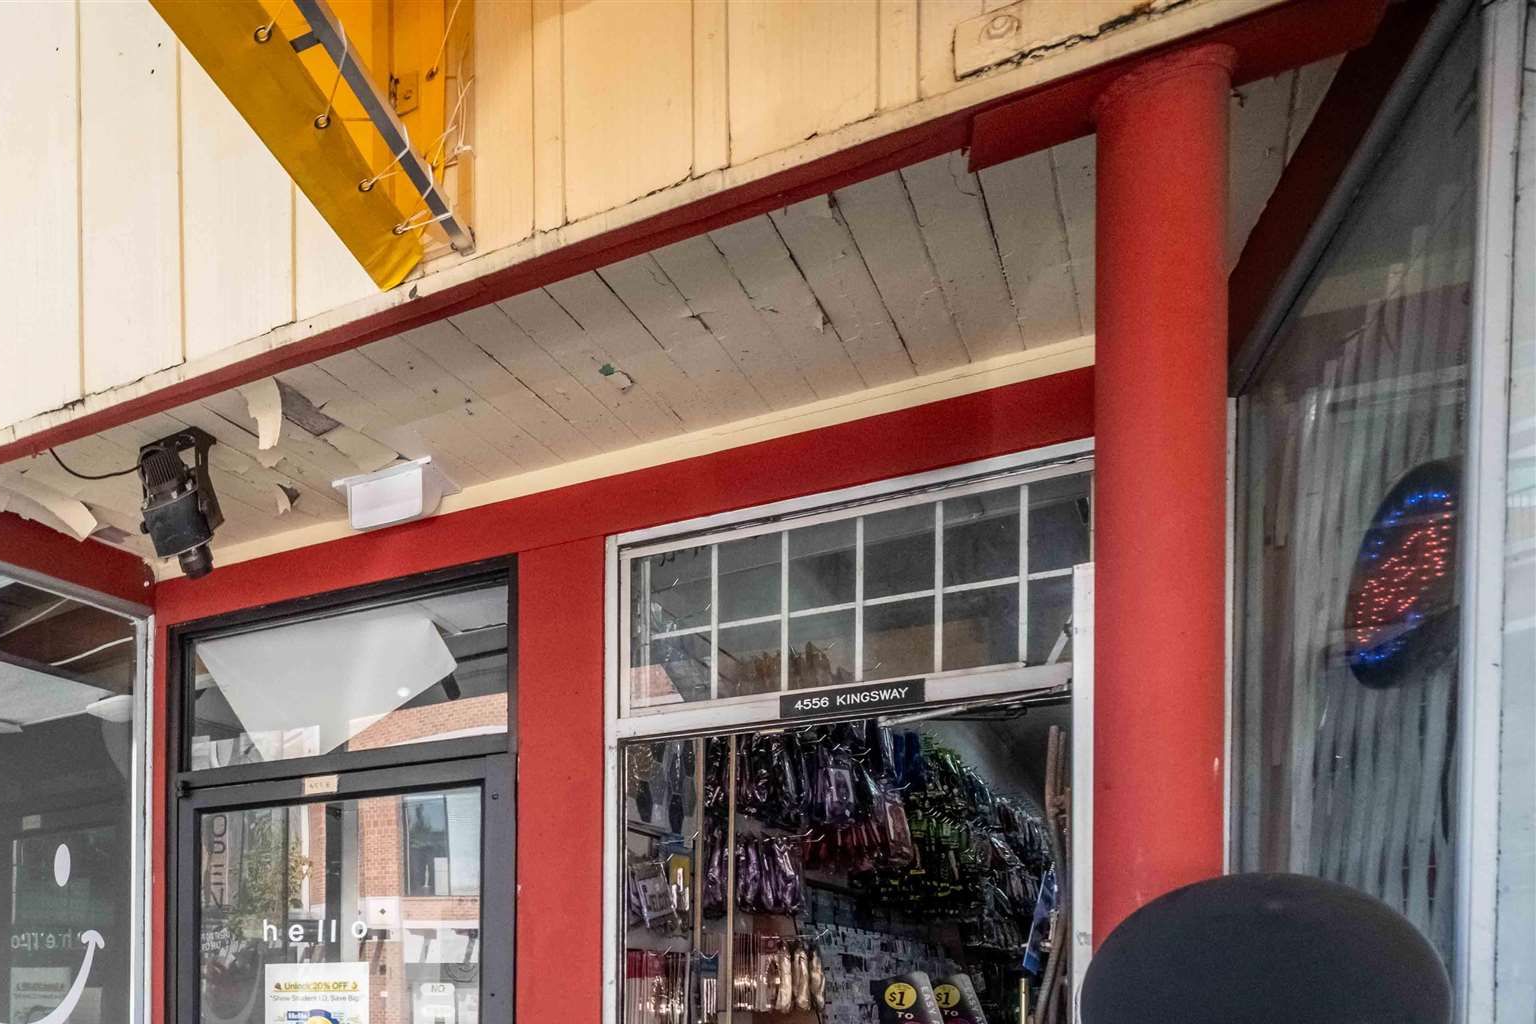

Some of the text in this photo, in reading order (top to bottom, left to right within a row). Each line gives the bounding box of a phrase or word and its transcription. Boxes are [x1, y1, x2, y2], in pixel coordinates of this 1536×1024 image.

[794, 686, 909, 711] 4556 KINGSWAY
[262, 919, 368, 944] hello
[332, 981, 348, 990] OFF
[889, 991, 906, 1007] $1
[921, 986, 937, 1015] EASY
[936, 991, 950, 1006] $1
[896, 1011, 915, 1020] TO
[943, 1009, 959, 1017] TO
